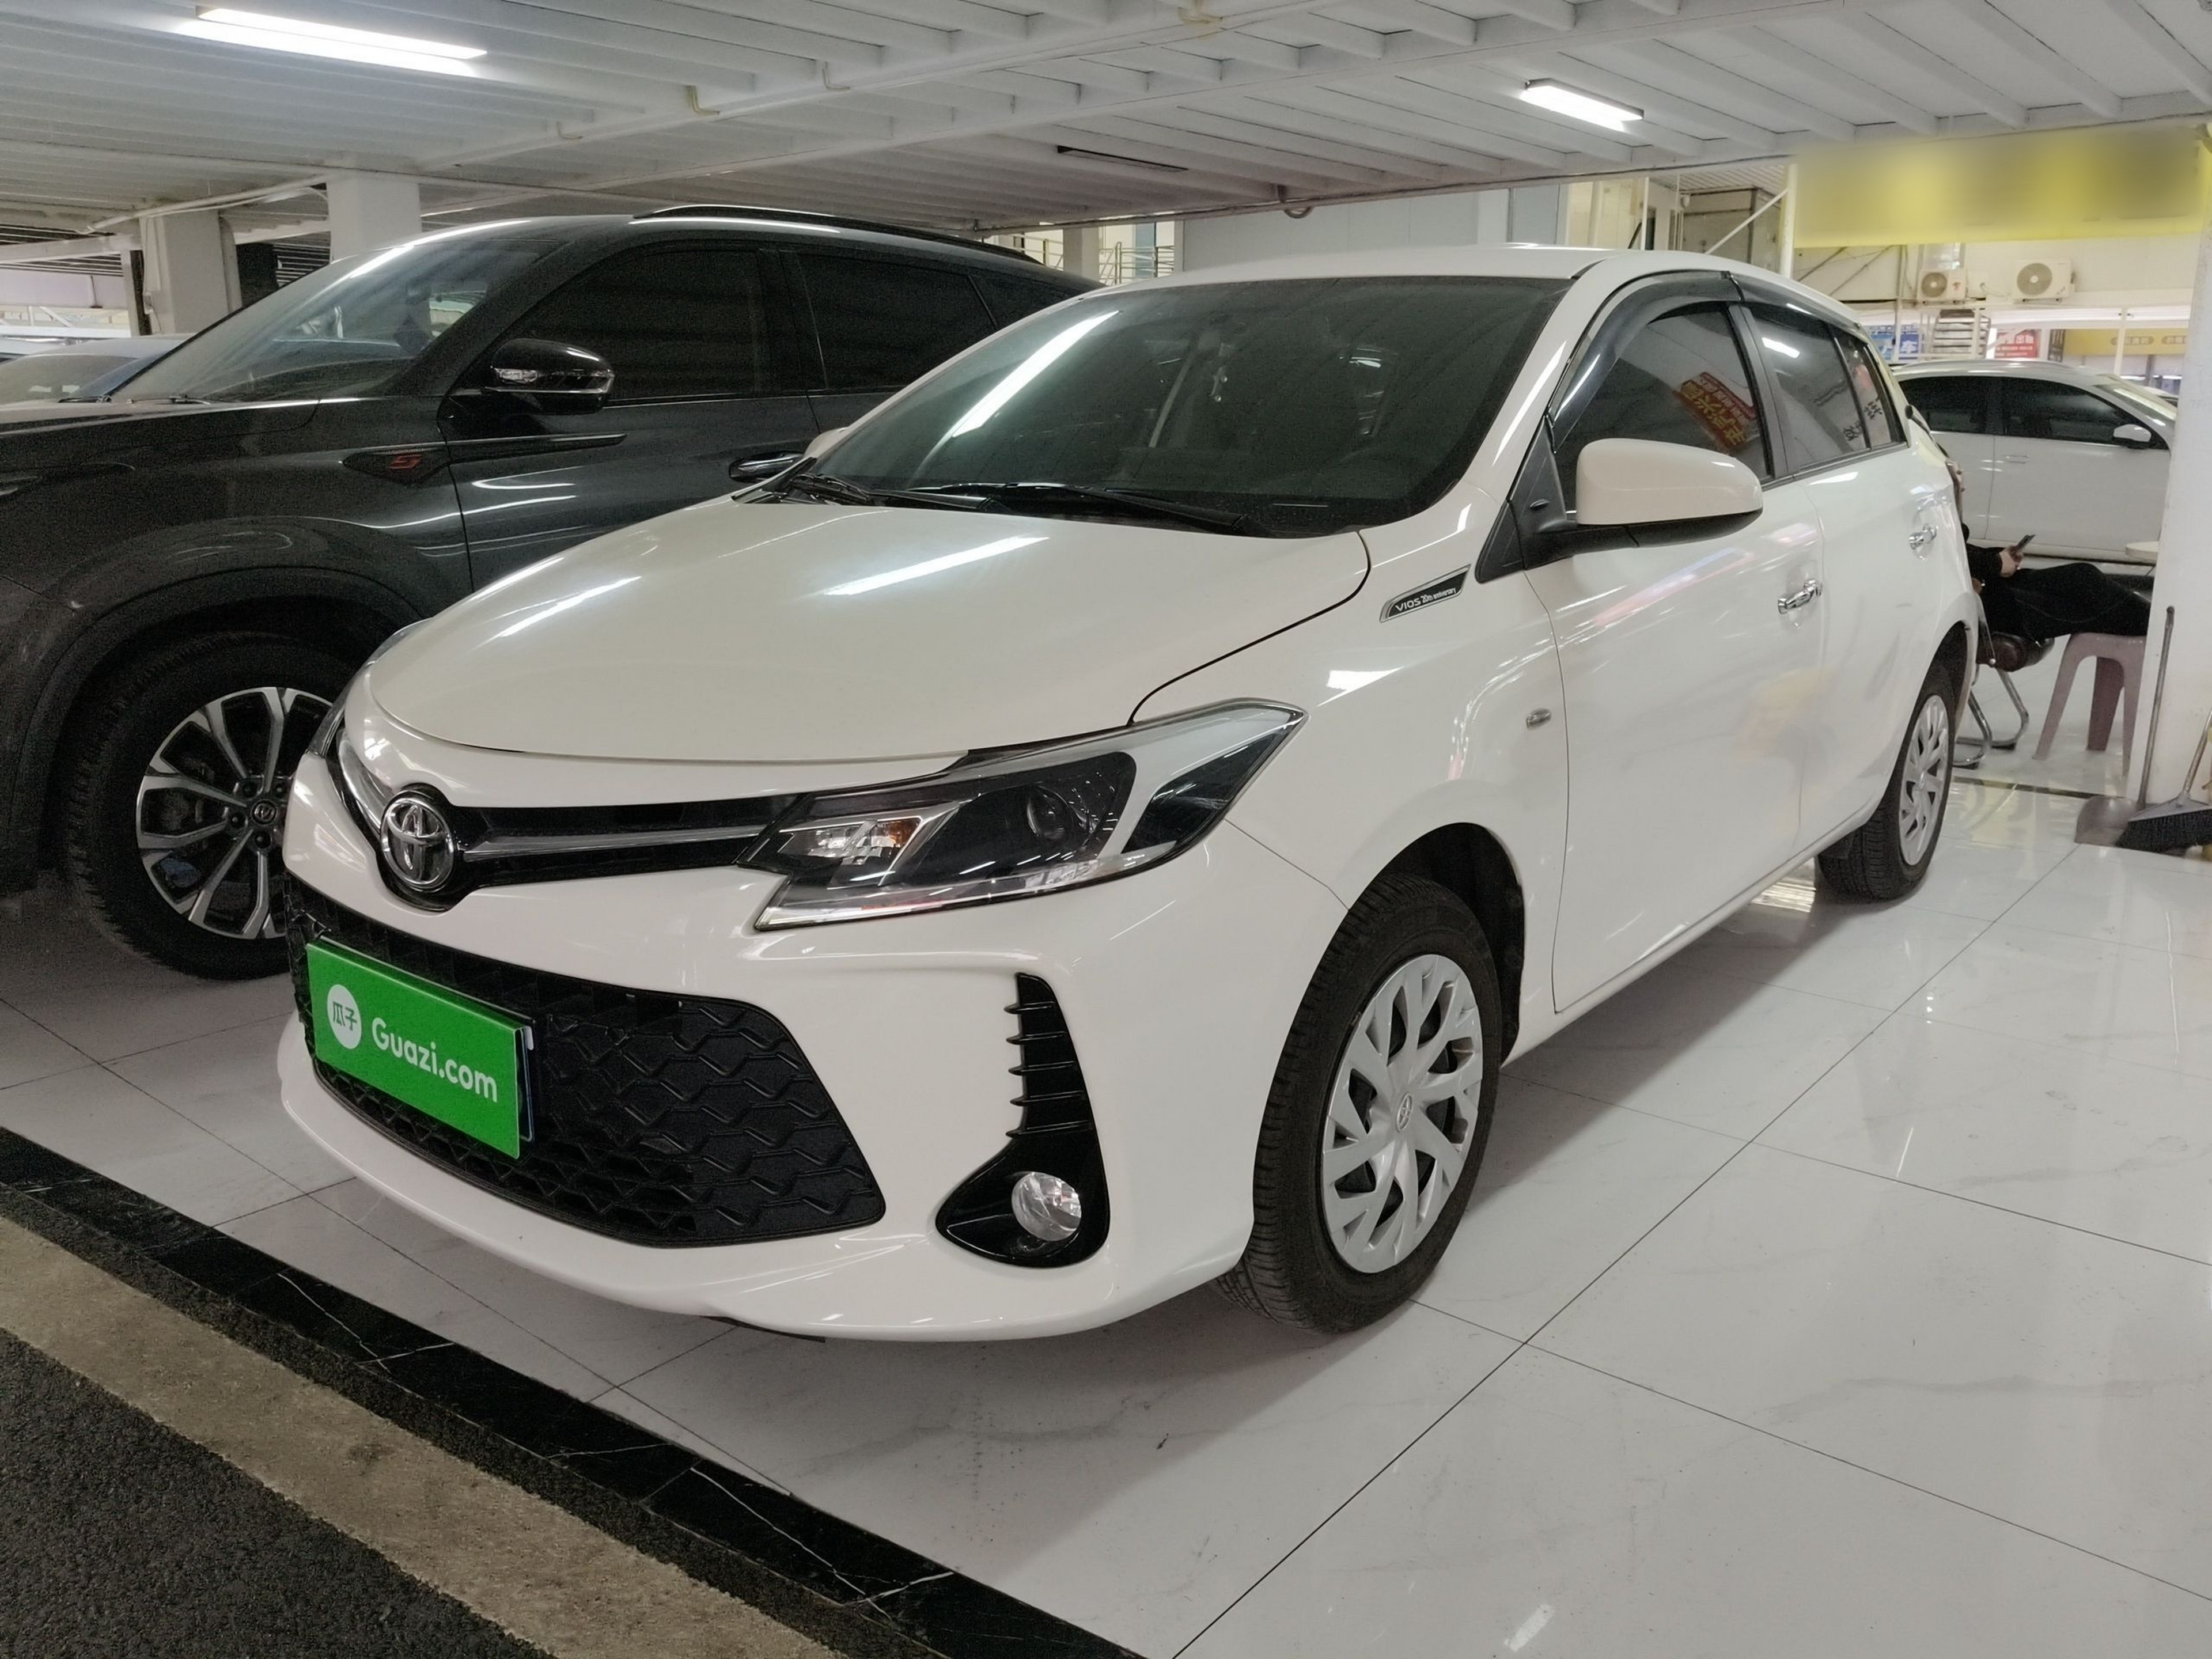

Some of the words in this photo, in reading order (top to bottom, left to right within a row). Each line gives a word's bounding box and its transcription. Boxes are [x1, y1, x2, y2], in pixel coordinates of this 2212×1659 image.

[1395, 597, 1421, 612] VIOS
[332, 1001, 358, 1032] 瓜子
[372, 1017, 498, 1103] Guazi.com
